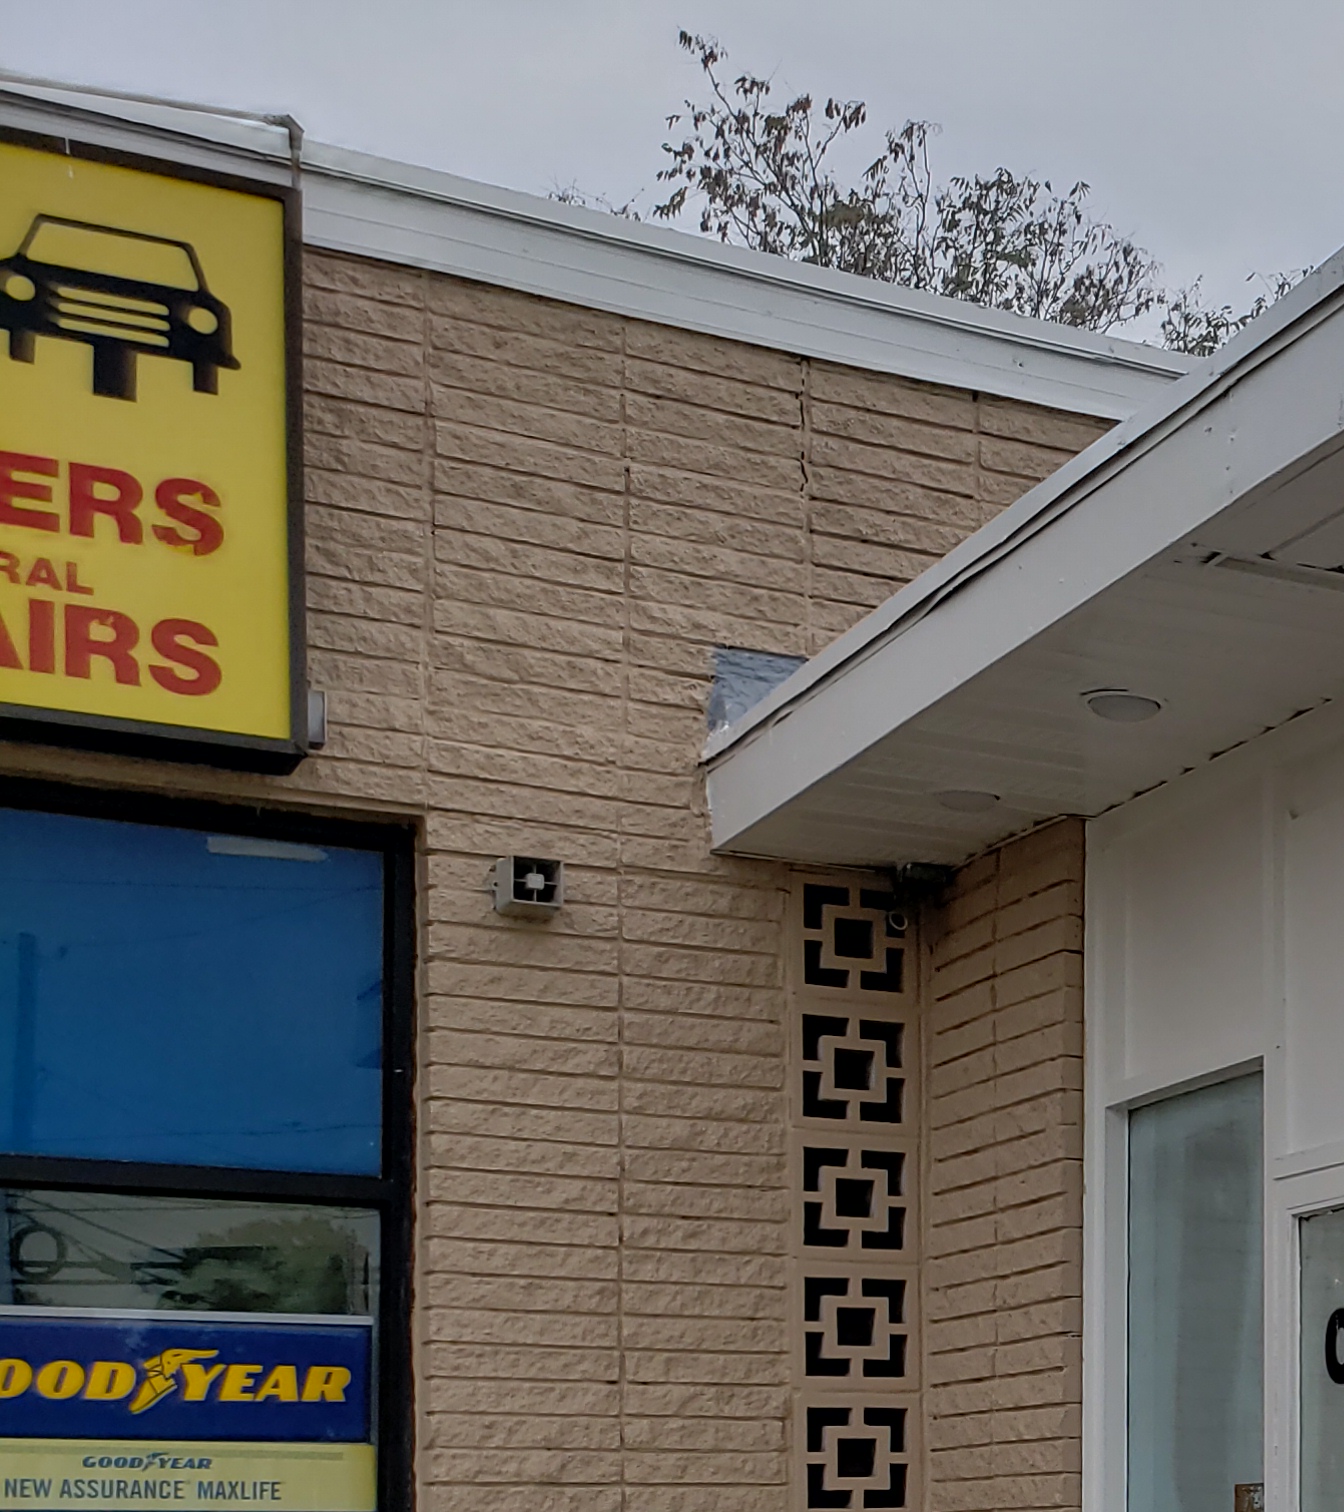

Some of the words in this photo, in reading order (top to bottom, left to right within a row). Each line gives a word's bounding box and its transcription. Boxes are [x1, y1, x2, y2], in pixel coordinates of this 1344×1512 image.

[0, 450, 224, 557] ERS
[4, 1478, 52, 1499] NEW
[60, 1478, 185, 1500] ASSURANCE
[198, 1481, 282, 1501] MAXLIFE
